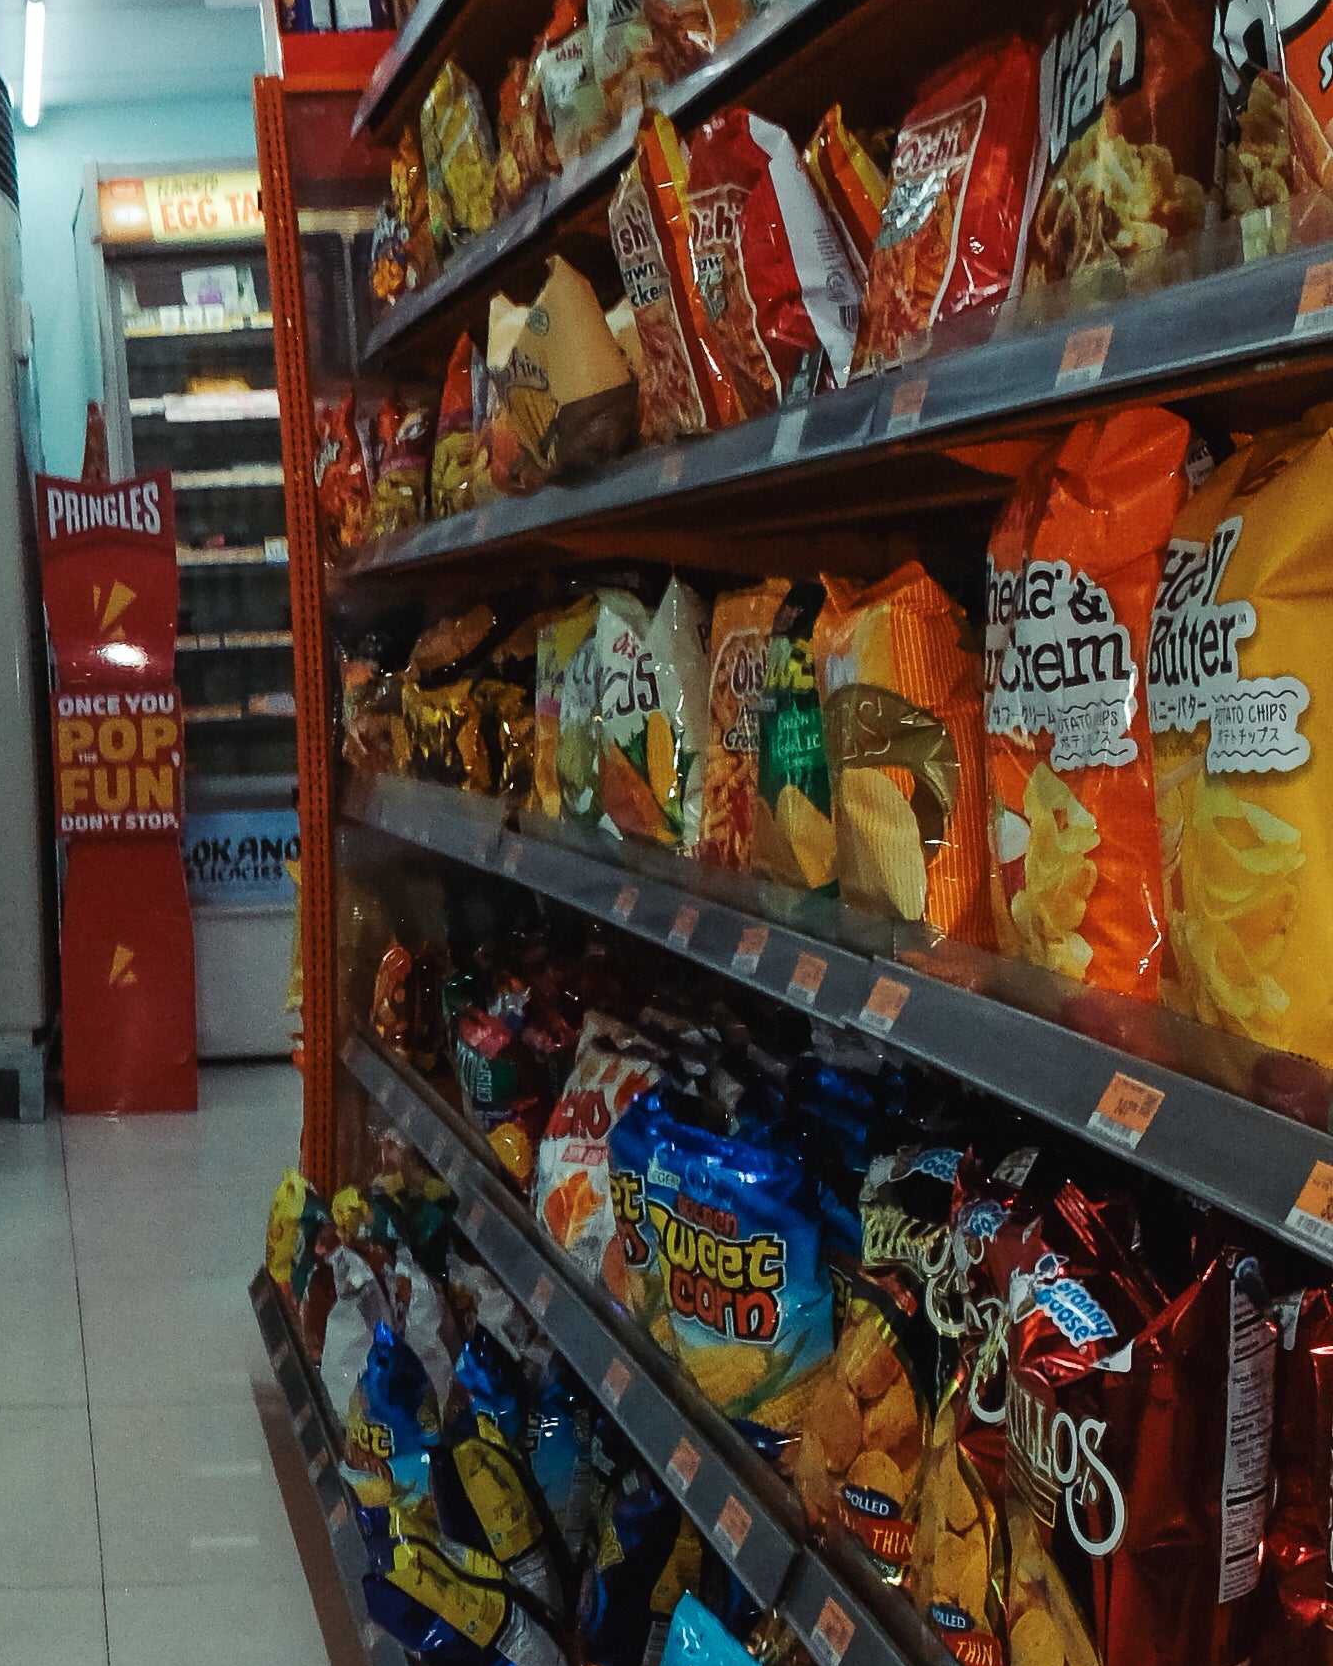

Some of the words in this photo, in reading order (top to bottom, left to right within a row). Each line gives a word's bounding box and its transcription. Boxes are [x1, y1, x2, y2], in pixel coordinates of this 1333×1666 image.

[161, 197, 218, 234] EGG
[48, 481, 161, 540] PRINGLES
[1068, 578, 1107, 624] &
[1149, 614, 1235, 687] Butter
[58, 695, 121, 717] ONCE
[125, 693, 174, 715] YOU
[1248, 702, 1288, 723] CHIPS
[61, 765, 174, 811] FUN
[62, 813, 121, 833] DON'T
[873, 1529, 914, 1554] THIN
[933, 1609, 966, 1629] OLLED
[956, 1641, 993, 1666] THIN
